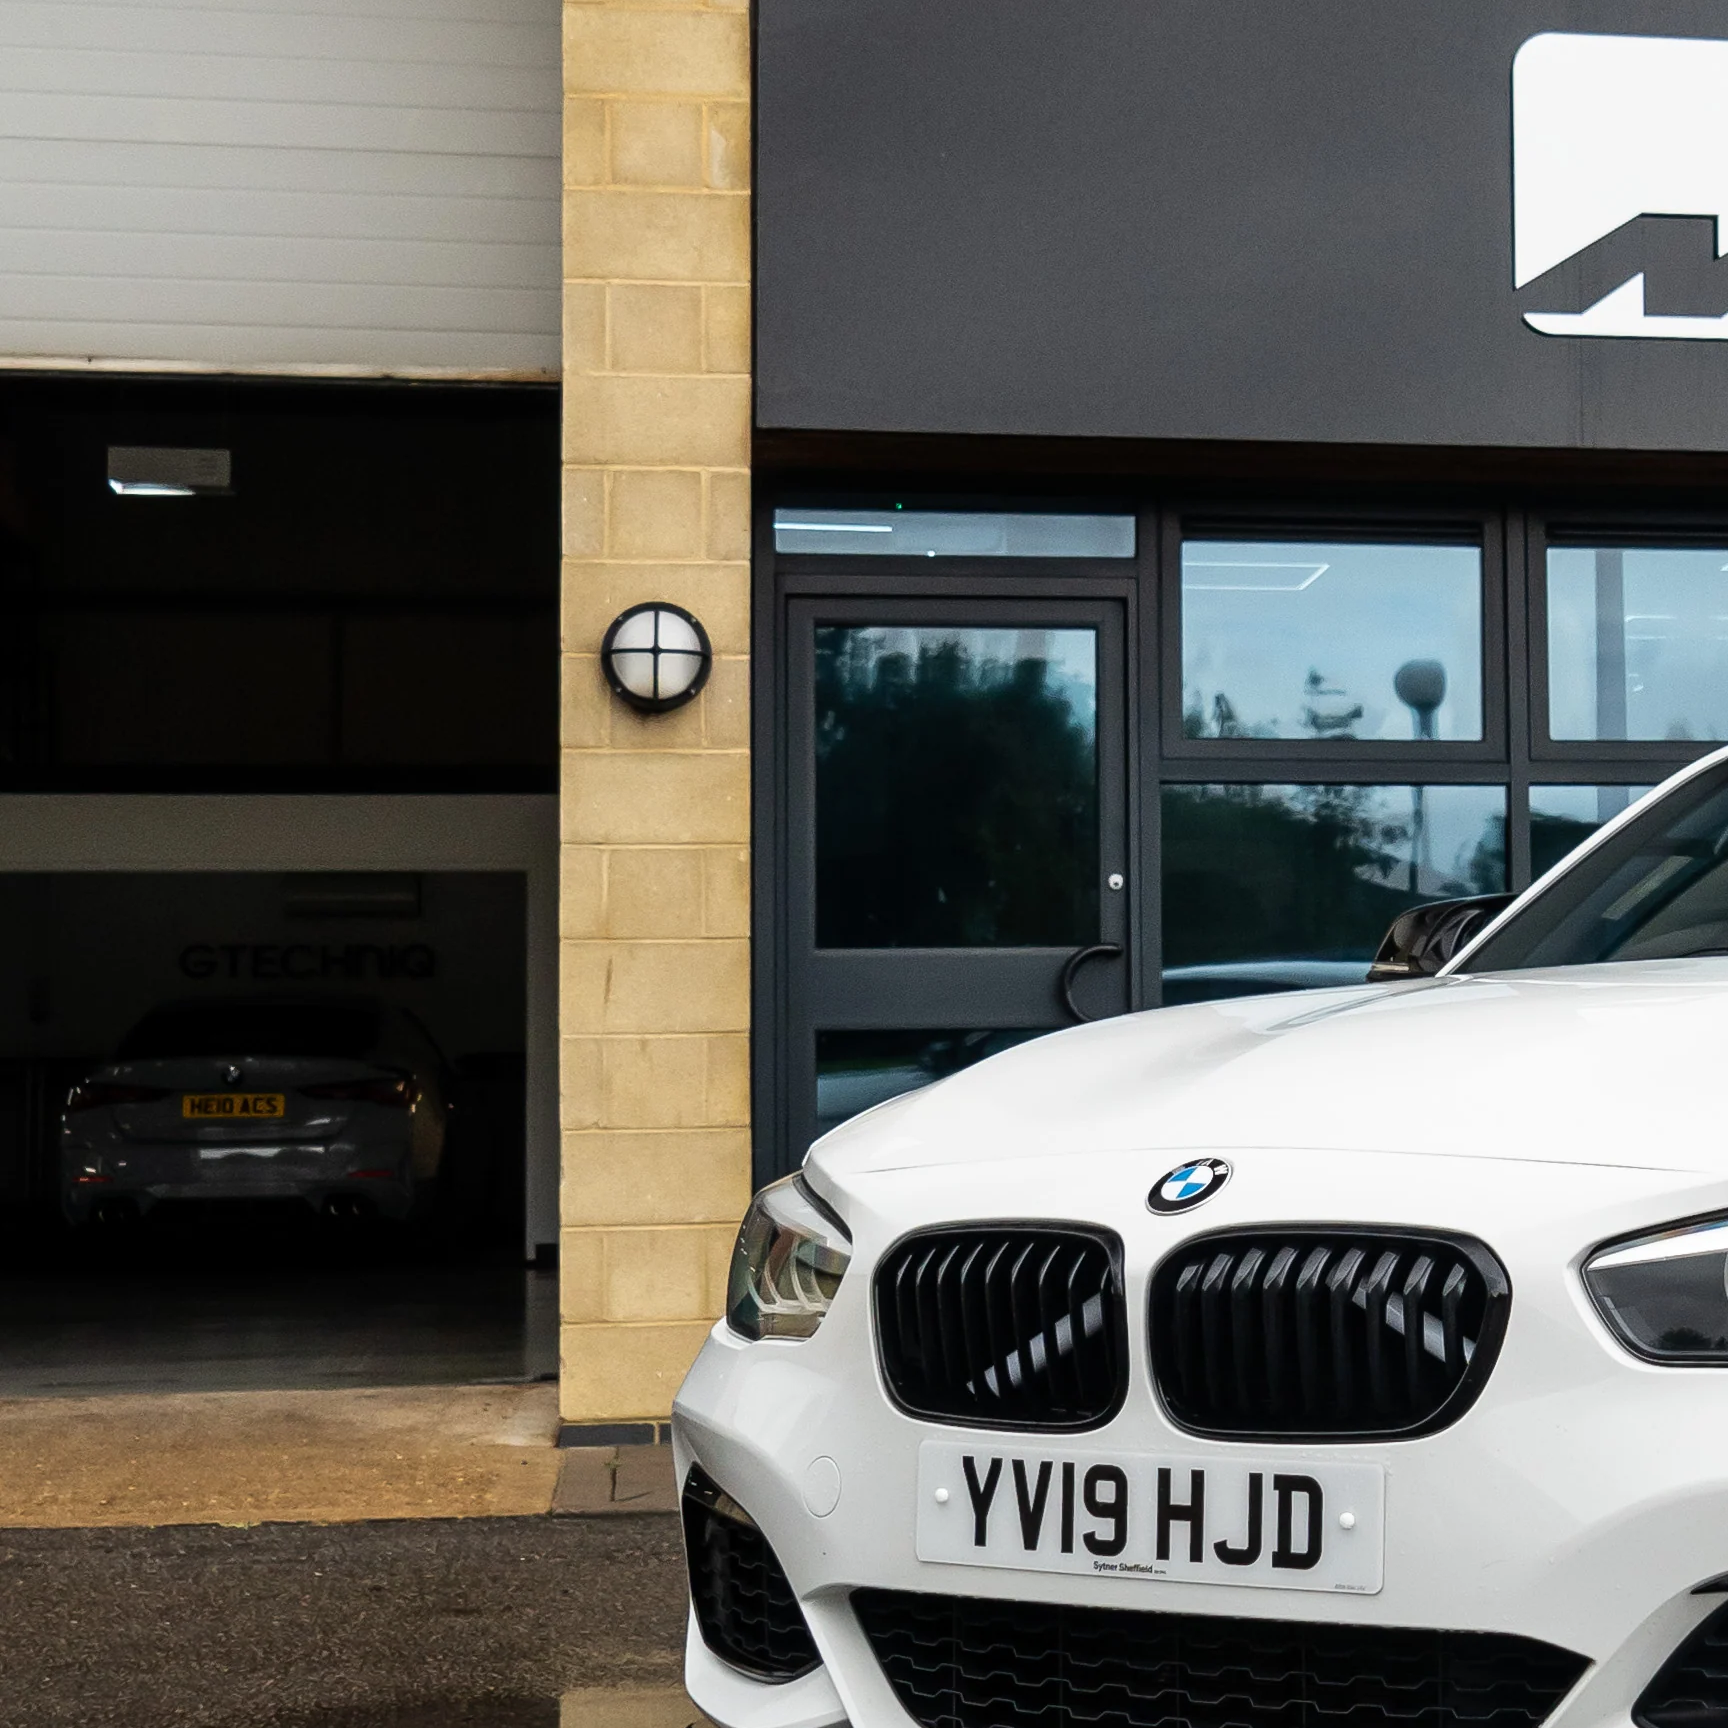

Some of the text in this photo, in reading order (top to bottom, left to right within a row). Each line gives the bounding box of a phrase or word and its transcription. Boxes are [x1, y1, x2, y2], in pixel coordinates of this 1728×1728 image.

[961, 1454, 1324, 1570] YV19 HJD
[1093, 1560, 1118, 1572] Sytner
[1119, 1562, 1153, 1574] Sheffield
